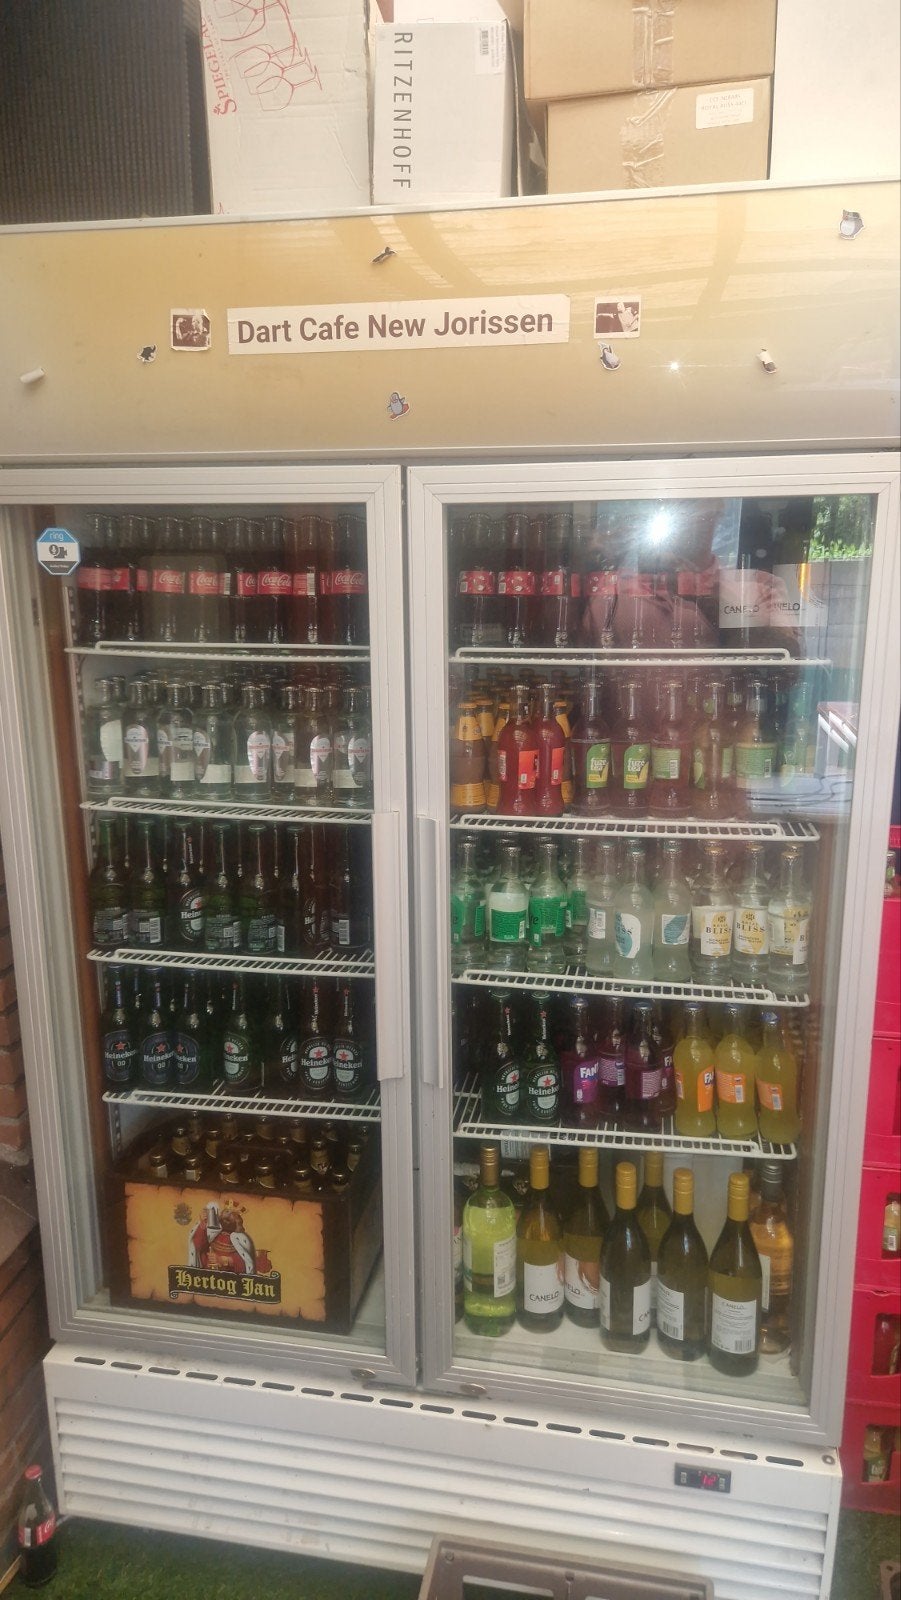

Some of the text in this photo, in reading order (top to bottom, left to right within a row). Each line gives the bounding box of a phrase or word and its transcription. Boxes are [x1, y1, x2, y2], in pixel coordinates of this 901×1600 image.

[393, 31, 413, 189] RITZENHOFF
[238, 309, 553, 344] Dart Cafe New Jorissen
[49, 531, 64, 541] ring
[580, 1062, 599, 1079] FANT
[175, 1269, 276, 1297] Hertog Jan
[529, 1290, 560, 1302] CANELO
